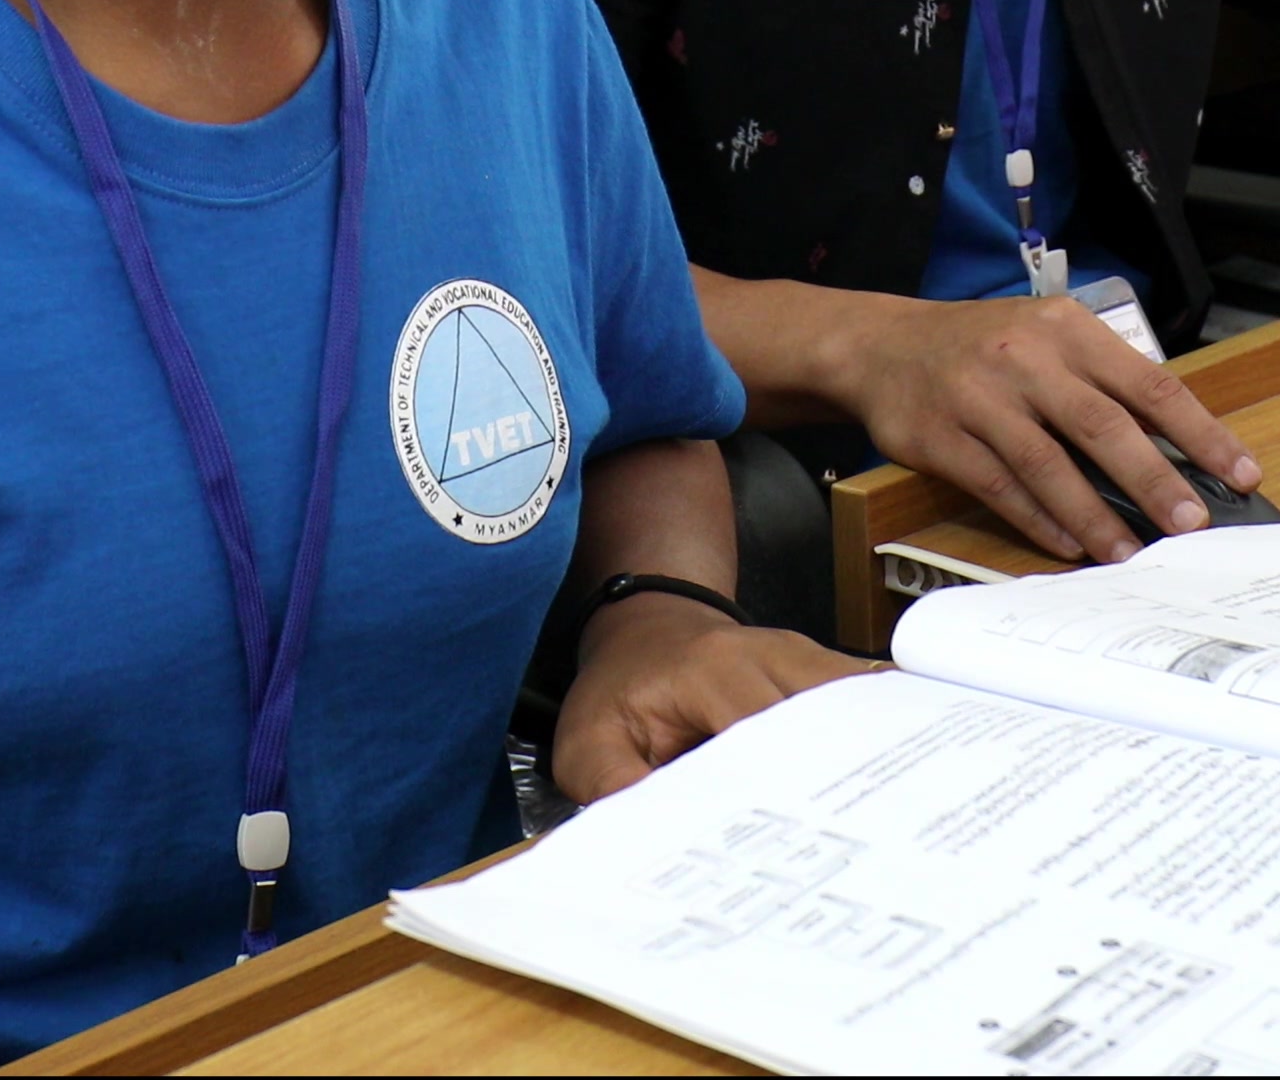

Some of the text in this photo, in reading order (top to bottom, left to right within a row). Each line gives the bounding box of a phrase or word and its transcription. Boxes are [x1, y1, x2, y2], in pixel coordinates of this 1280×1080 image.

[398, 284, 567, 504] DEPARTMENT OF TECHNICAL AND VOCATIONAL EDUCATION AND TRAINING
[451, 410, 534, 467] TVET
[473, 496, 544, 537] MYANMAR
